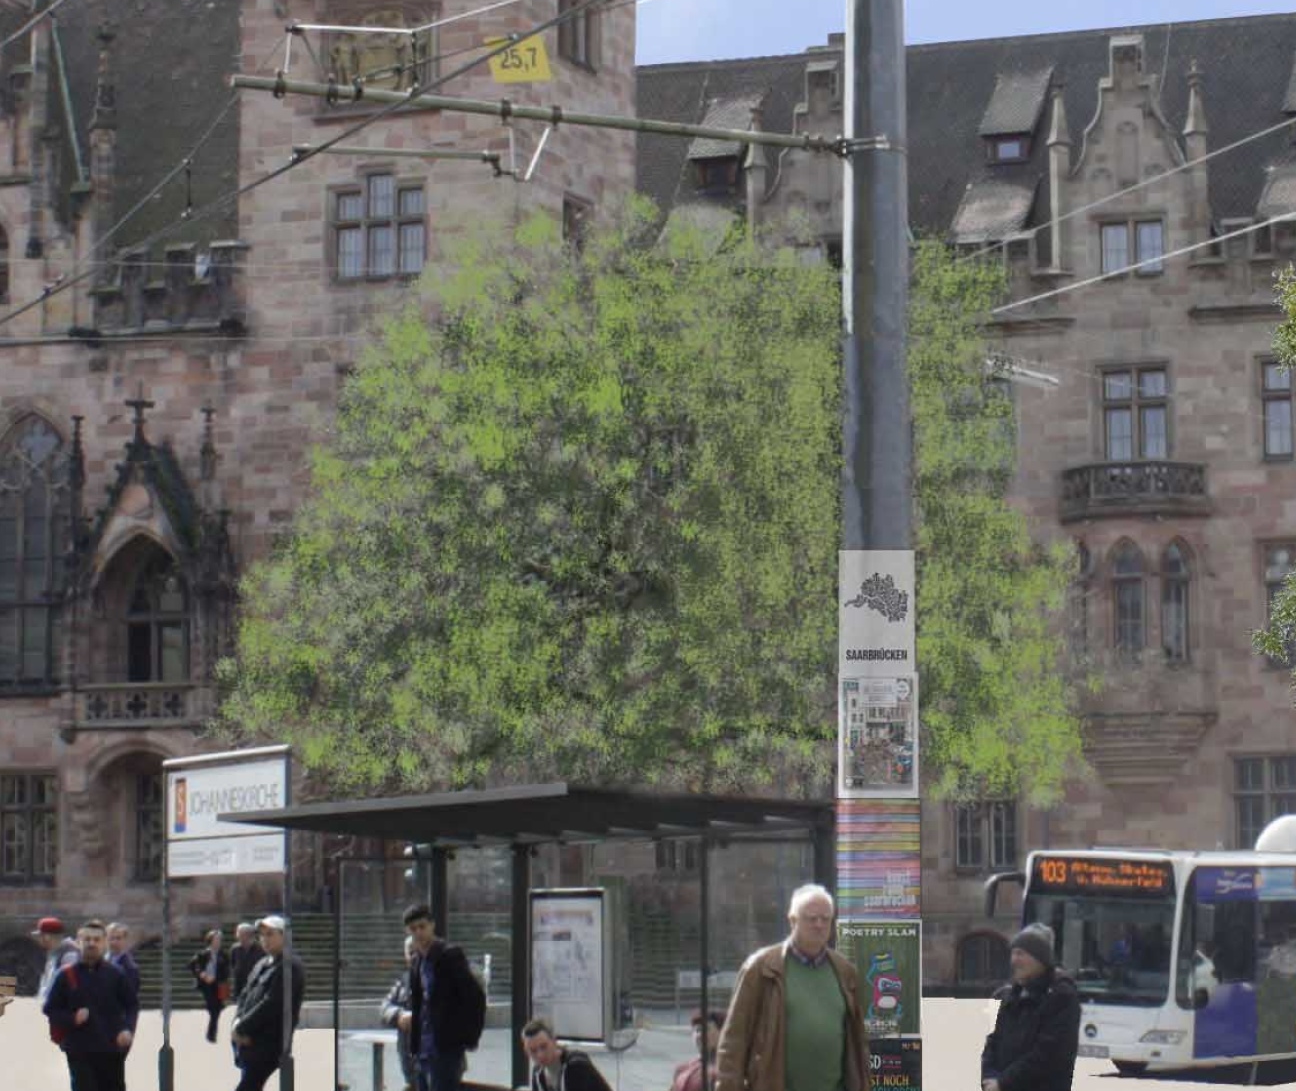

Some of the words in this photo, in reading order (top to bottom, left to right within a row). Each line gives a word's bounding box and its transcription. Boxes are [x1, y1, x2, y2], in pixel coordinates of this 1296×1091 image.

[501, 46, 537, 73] 25,7
[845, 648, 908, 661] SAARBRÜCKEN
[1040, 860, 1066, 884] 103
[842, 928, 884, 938] POETRY
[887, 928, 917, 938] SLAM
[883, 1075, 910, 1086] NOCH
